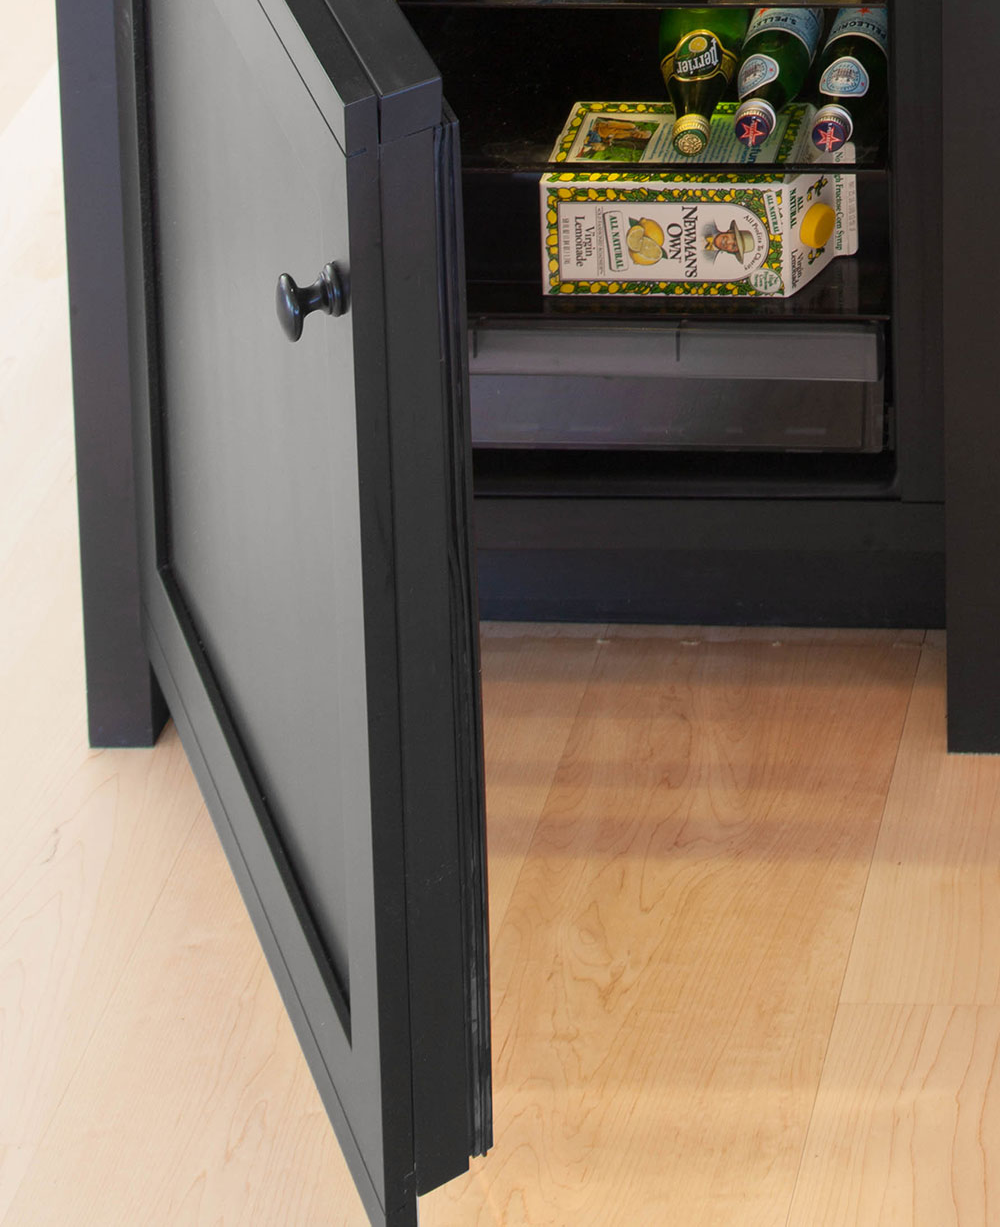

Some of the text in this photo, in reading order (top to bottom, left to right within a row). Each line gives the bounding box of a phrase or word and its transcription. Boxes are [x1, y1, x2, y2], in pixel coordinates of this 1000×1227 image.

[834, 151, 844, 163] No
[789, 188, 798, 229] NATURAL
[835, 183, 844, 211] Fructose
[744, 214, 754, 223] All
[770, 206, 779, 233] NATURAL
[836, 211, 844, 230] Corn
[575, 216, 587, 267] Lemonade
[583, 226, 595, 257] Virgin
[609, 215, 624, 269] ALL NATURAL
[667, 223, 683, 260] OWN
[682, 206, 698, 278] NEWMAN'S
[835, 230, 845, 251] Syrup
